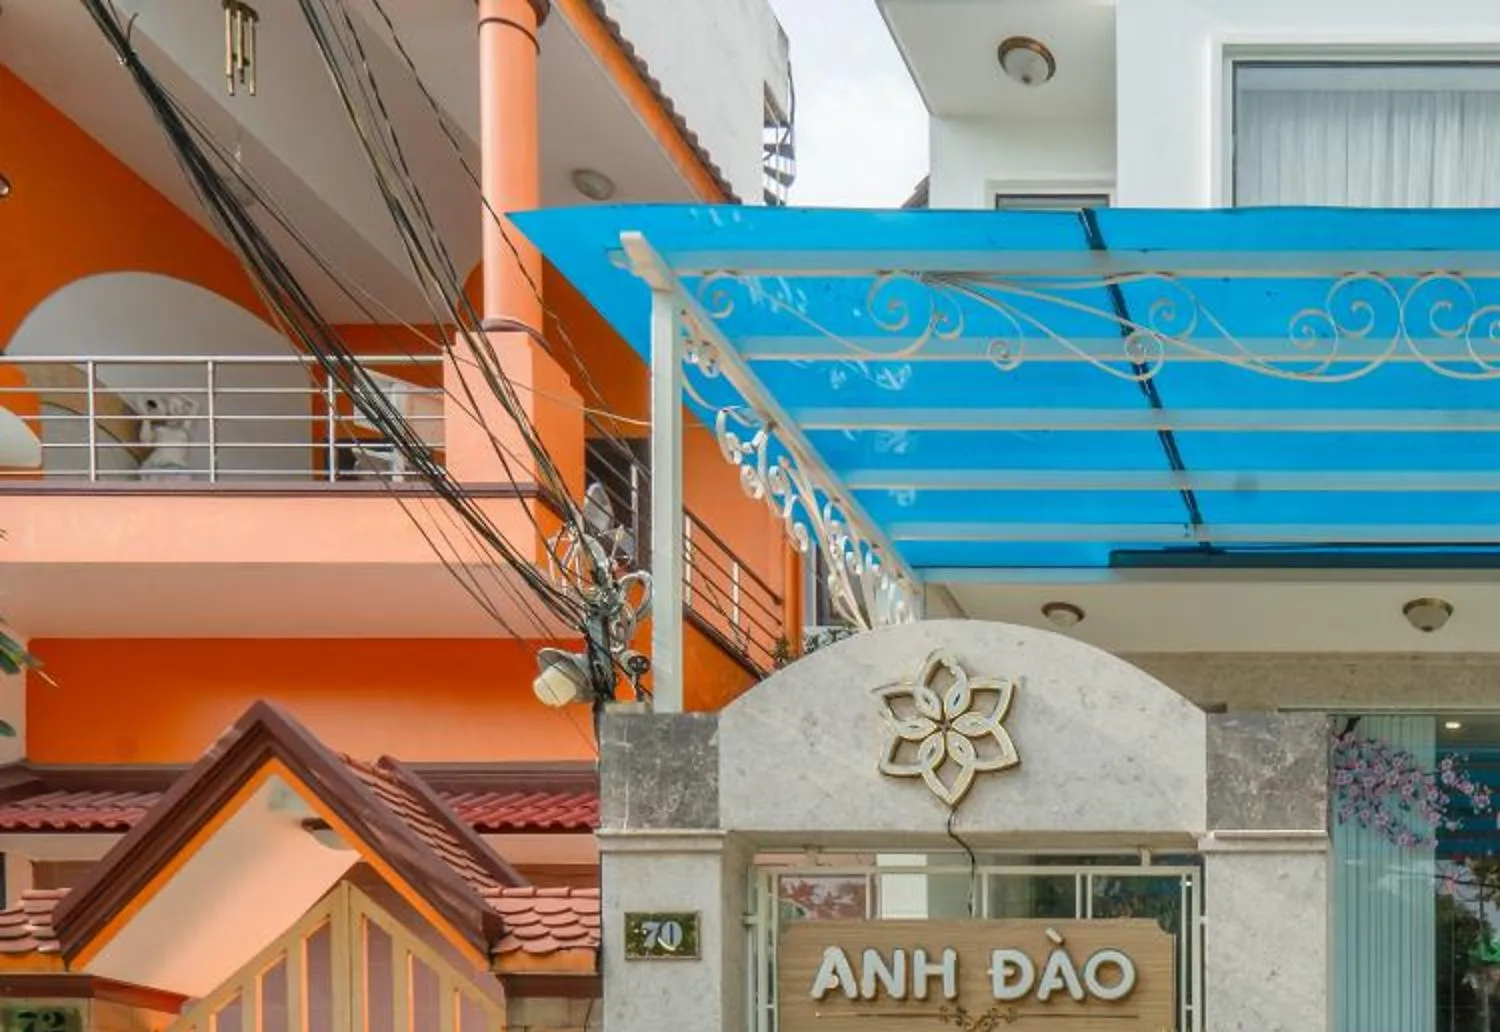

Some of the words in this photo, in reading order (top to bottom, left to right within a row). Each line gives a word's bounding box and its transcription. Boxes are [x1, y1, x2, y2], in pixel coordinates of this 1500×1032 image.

[641, 920, 683, 951] 70
[810, 945, 958, 1000] ANH
[987, 927, 1138, 1000] ĐÀO
